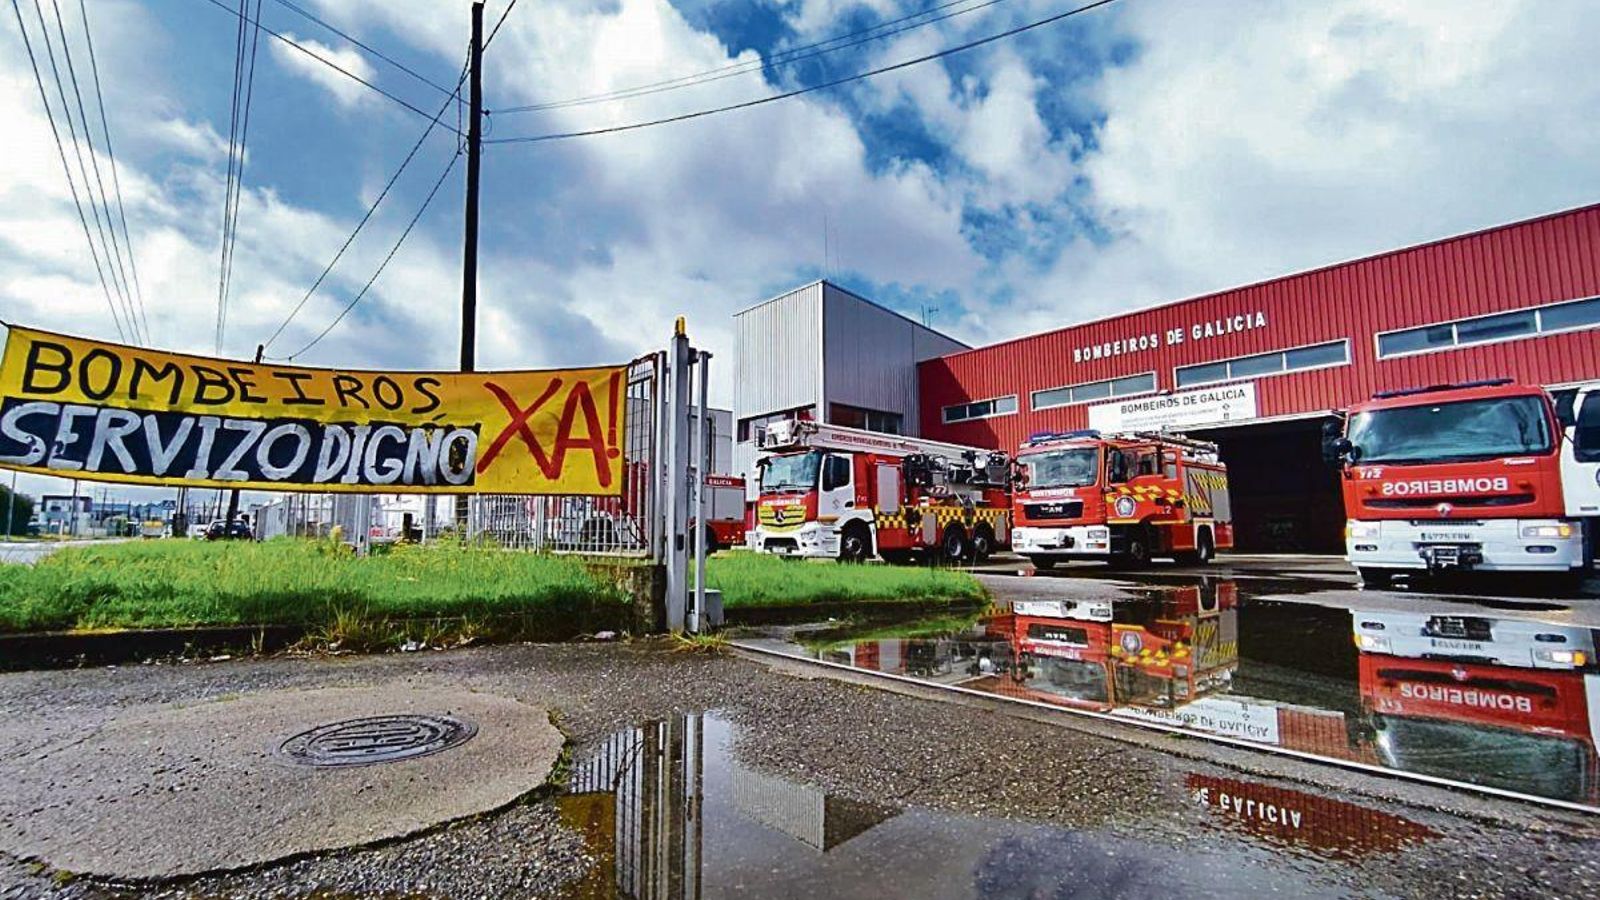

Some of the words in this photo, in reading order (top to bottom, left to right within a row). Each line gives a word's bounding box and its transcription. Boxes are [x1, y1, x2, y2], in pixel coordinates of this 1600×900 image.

[1073, 334, 1159, 363] BOMBEIROS
[1166, 328, 1184, 345] DE
[1192, 311, 1267, 341] GALICIA
[22, 340, 442, 415] BOMBEIROS
[1120, 397, 1180, 414] BOMBEIROS
[1183, 395, 1198, 406] DE
[1200, 389, 1246, 404] GALICIA
[0, 401, 312, 482] SERVIZO
[313, 424, 478, 485] DIGNO
[477, 371, 621, 488] XA!
